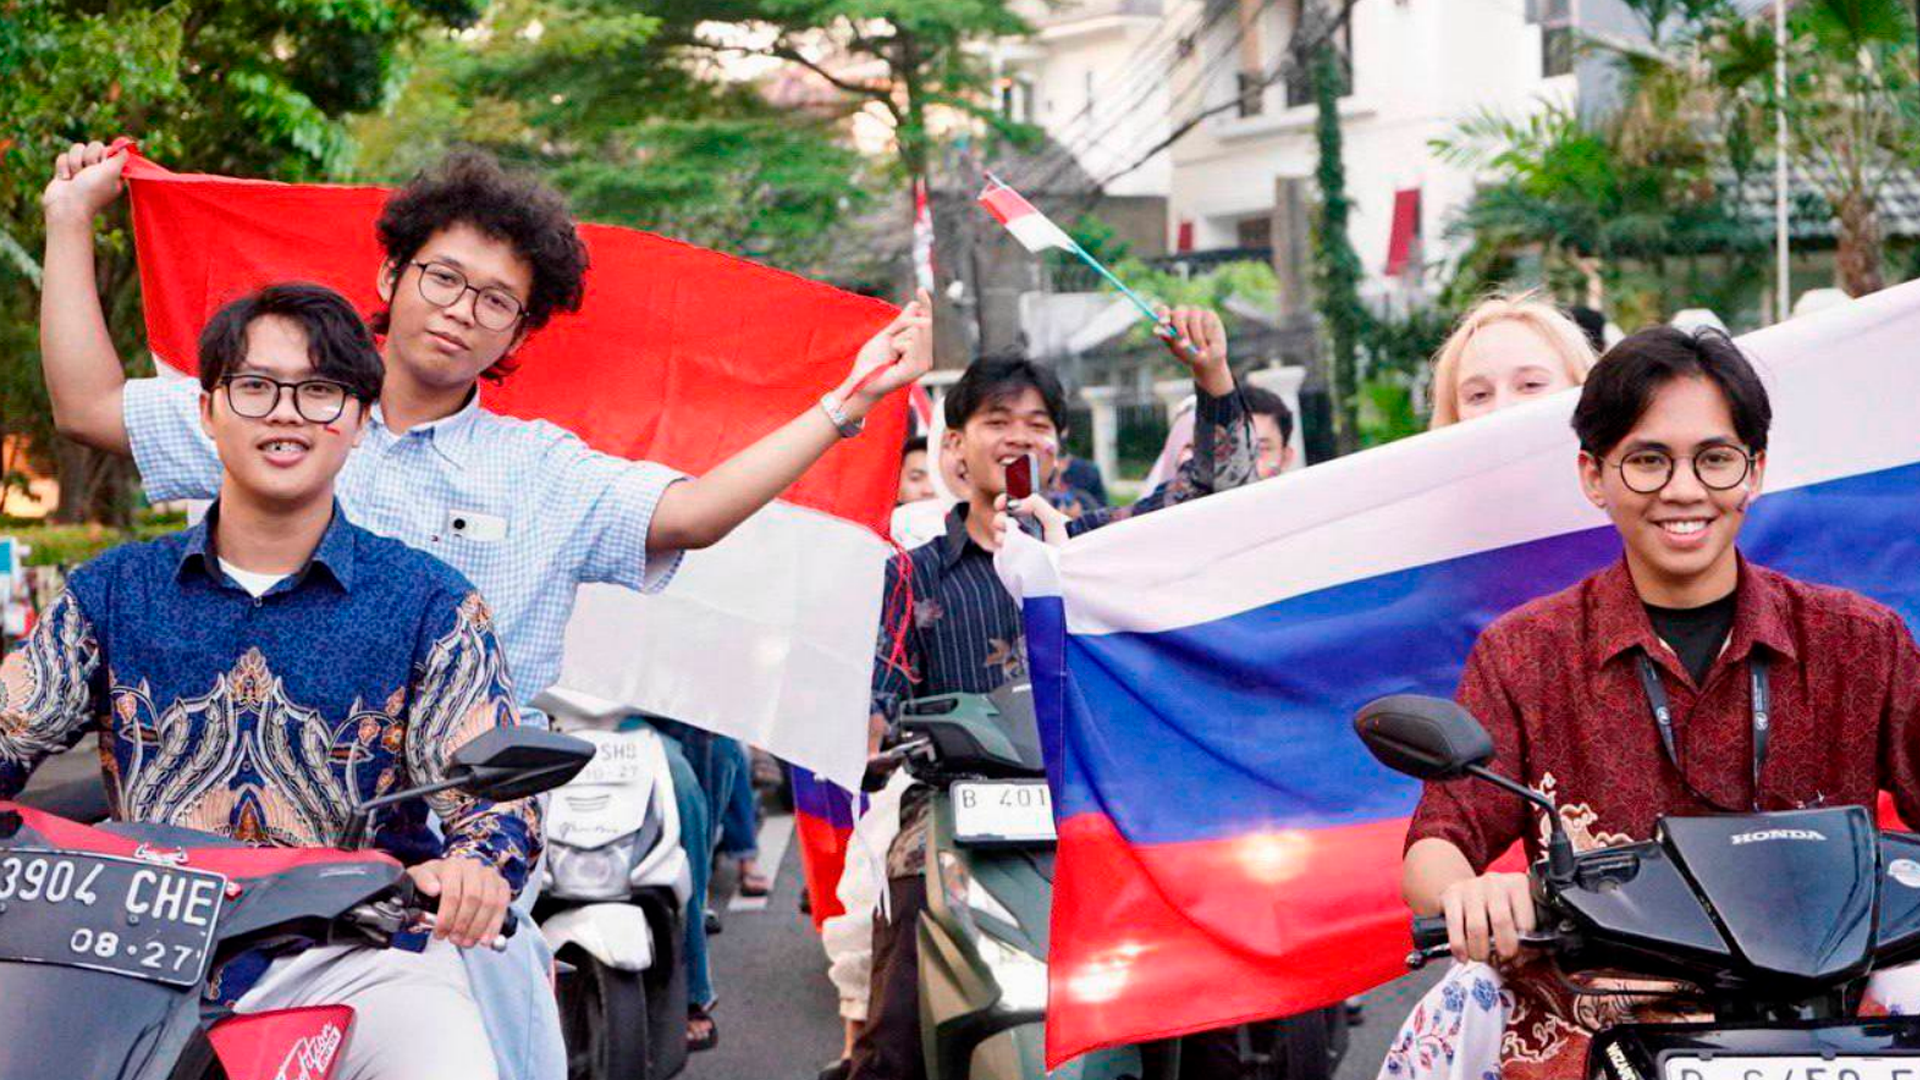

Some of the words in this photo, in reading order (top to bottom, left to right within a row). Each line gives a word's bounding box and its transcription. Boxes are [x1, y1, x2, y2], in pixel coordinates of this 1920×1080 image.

[962, 789, 977, 809] B
[1731, 829, 1828, 845] HONDA
[0, 857, 104, 905] 3904
[125, 870, 217, 926] CHE
